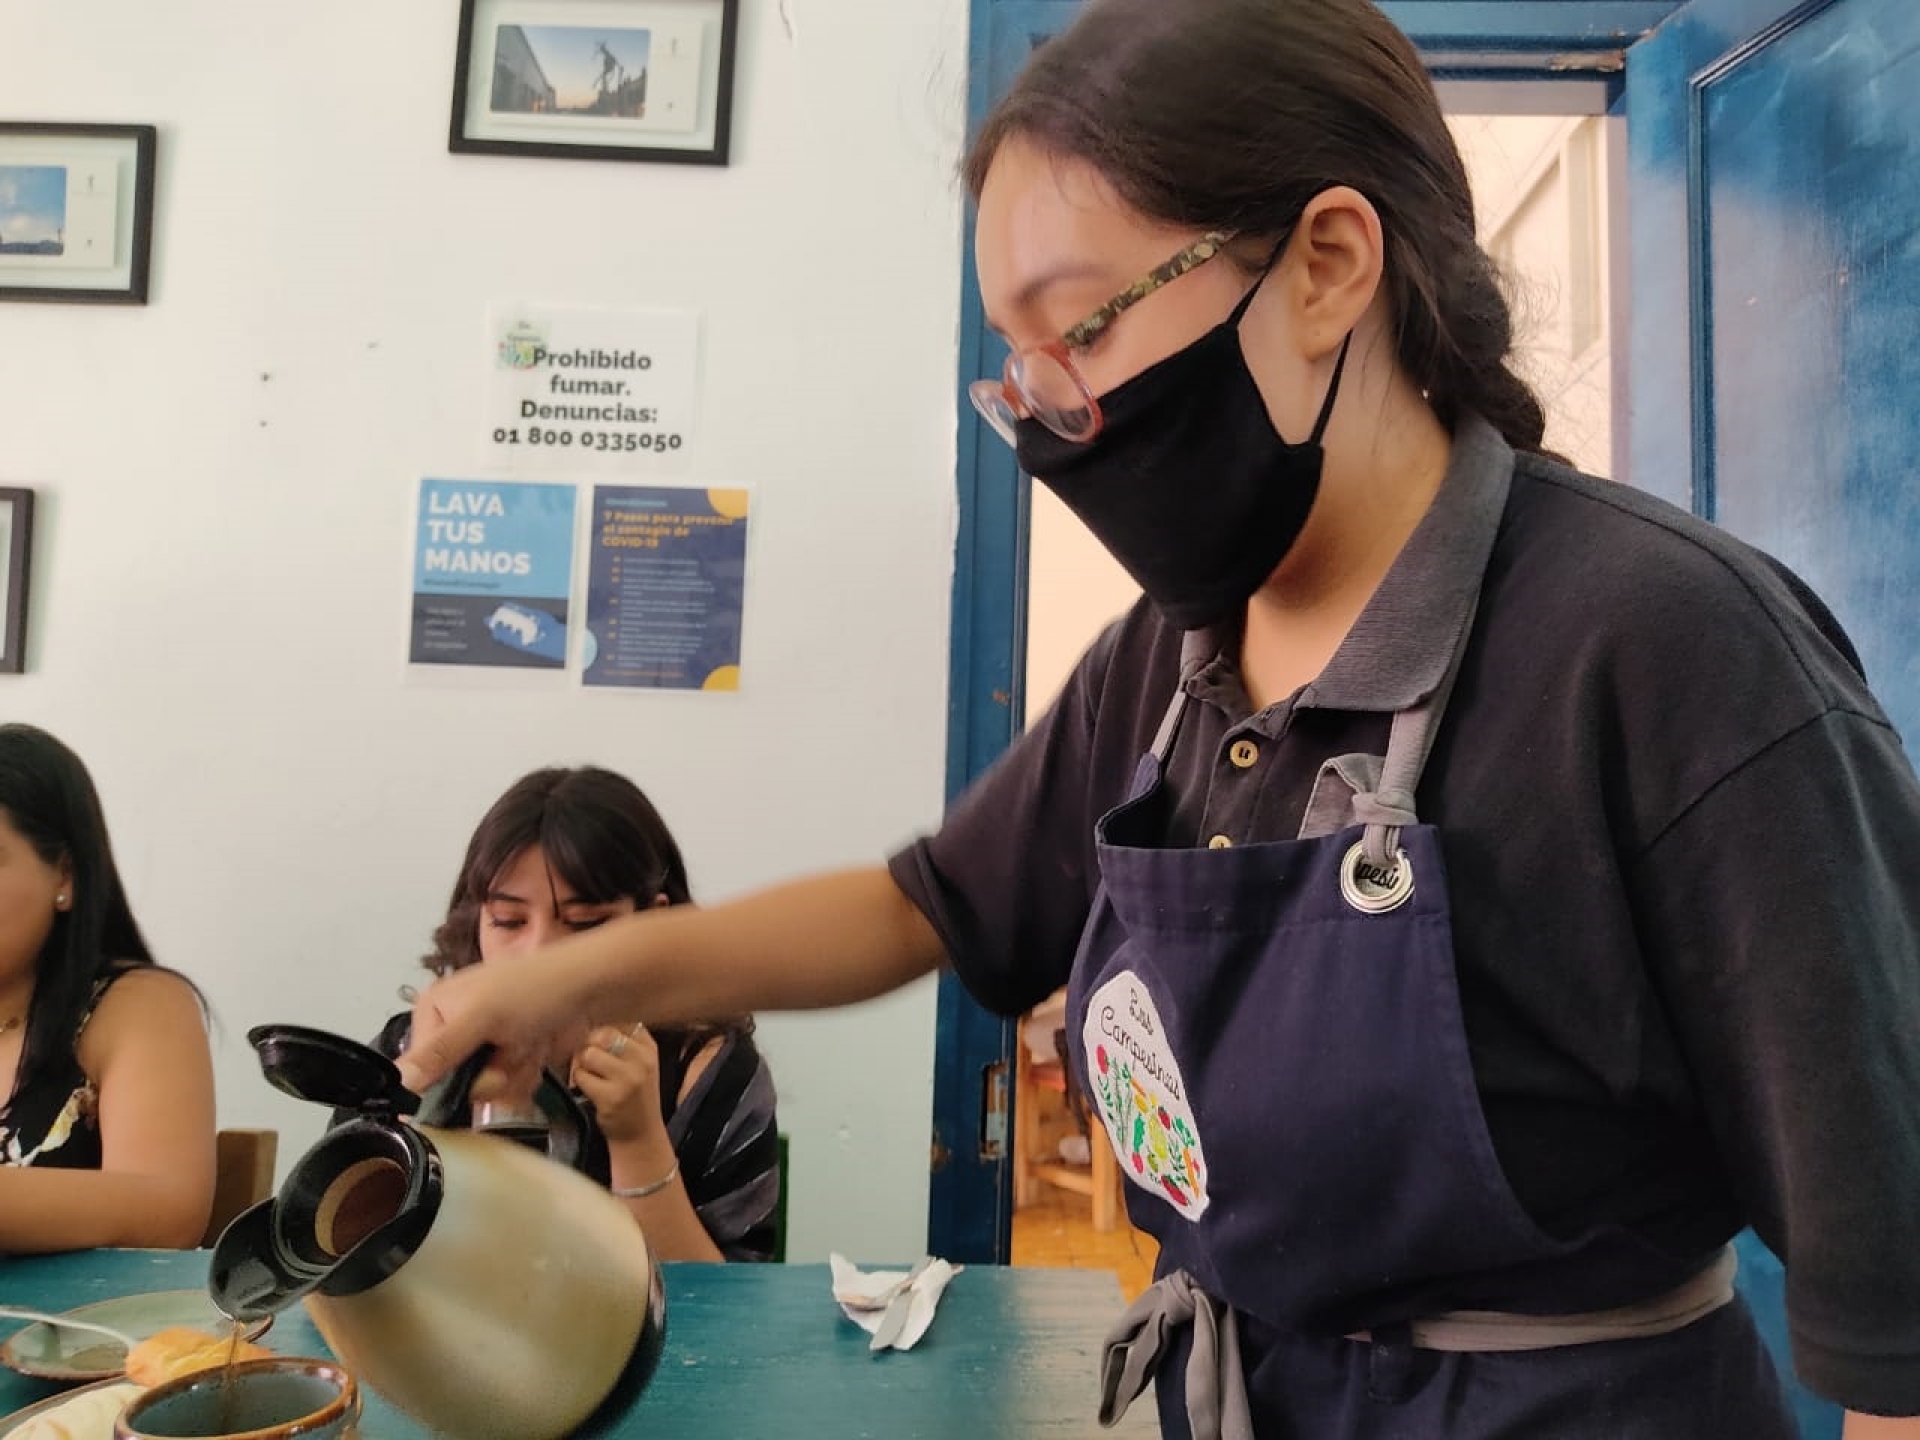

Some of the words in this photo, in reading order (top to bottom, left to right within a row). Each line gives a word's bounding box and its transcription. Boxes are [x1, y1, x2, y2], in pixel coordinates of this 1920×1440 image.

[532, 348, 652, 370] Prohibido
[550, 374, 632, 396] fumar.
[521, 400, 658, 423] Denuncias:
[493, 428, 520, 444] 01
[528, 427, 573, 446] 800
[581, 431, 682, 452] 0335050
[428, 491, 504, 516] LAVA
[427, 519, 485, 544] TUS
[425, 548, 532, 575] MANOS
